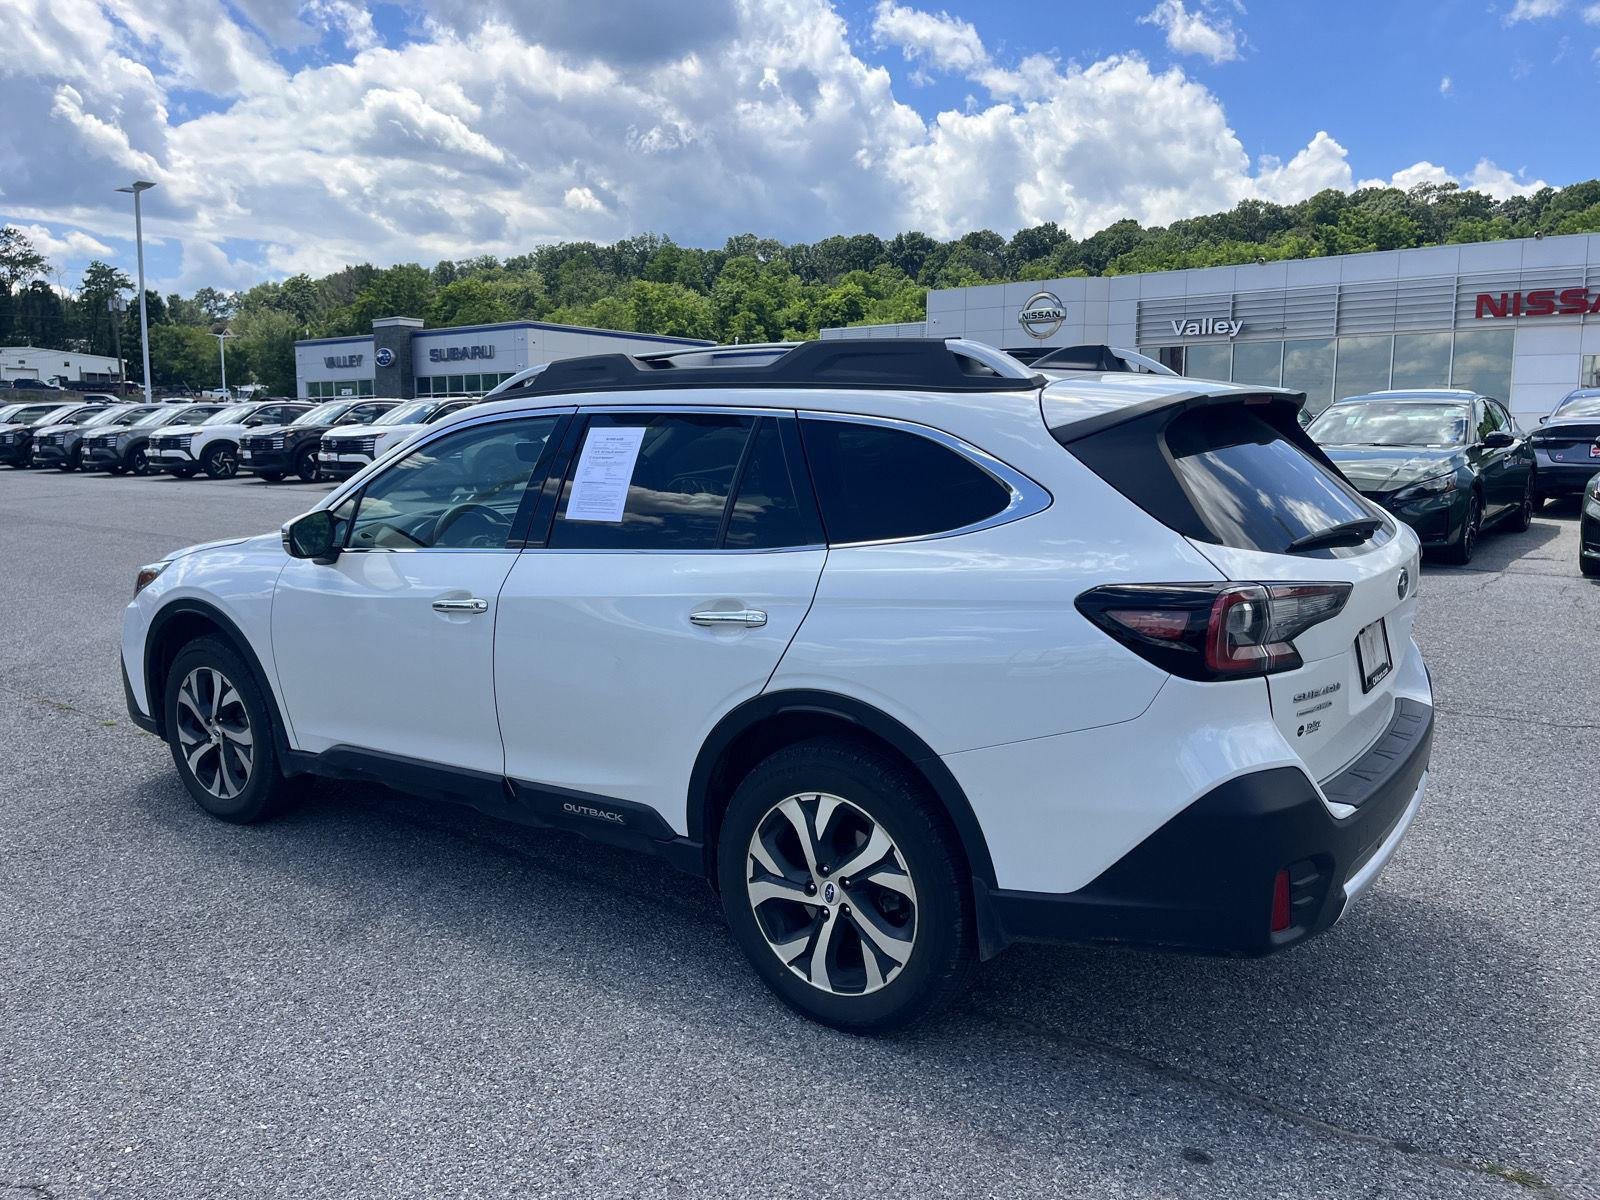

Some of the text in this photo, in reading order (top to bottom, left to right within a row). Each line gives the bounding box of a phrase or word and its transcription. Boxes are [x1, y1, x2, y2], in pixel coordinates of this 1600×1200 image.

[1022, 309, 1061, 320] NISSAN
[1171, 319, 1243, 337] Valley
[323, 355, 364, 369] VALLEY
[429, 345, 495, 363] SUBARU
[563, 803, 624, 822] OUTBACK
